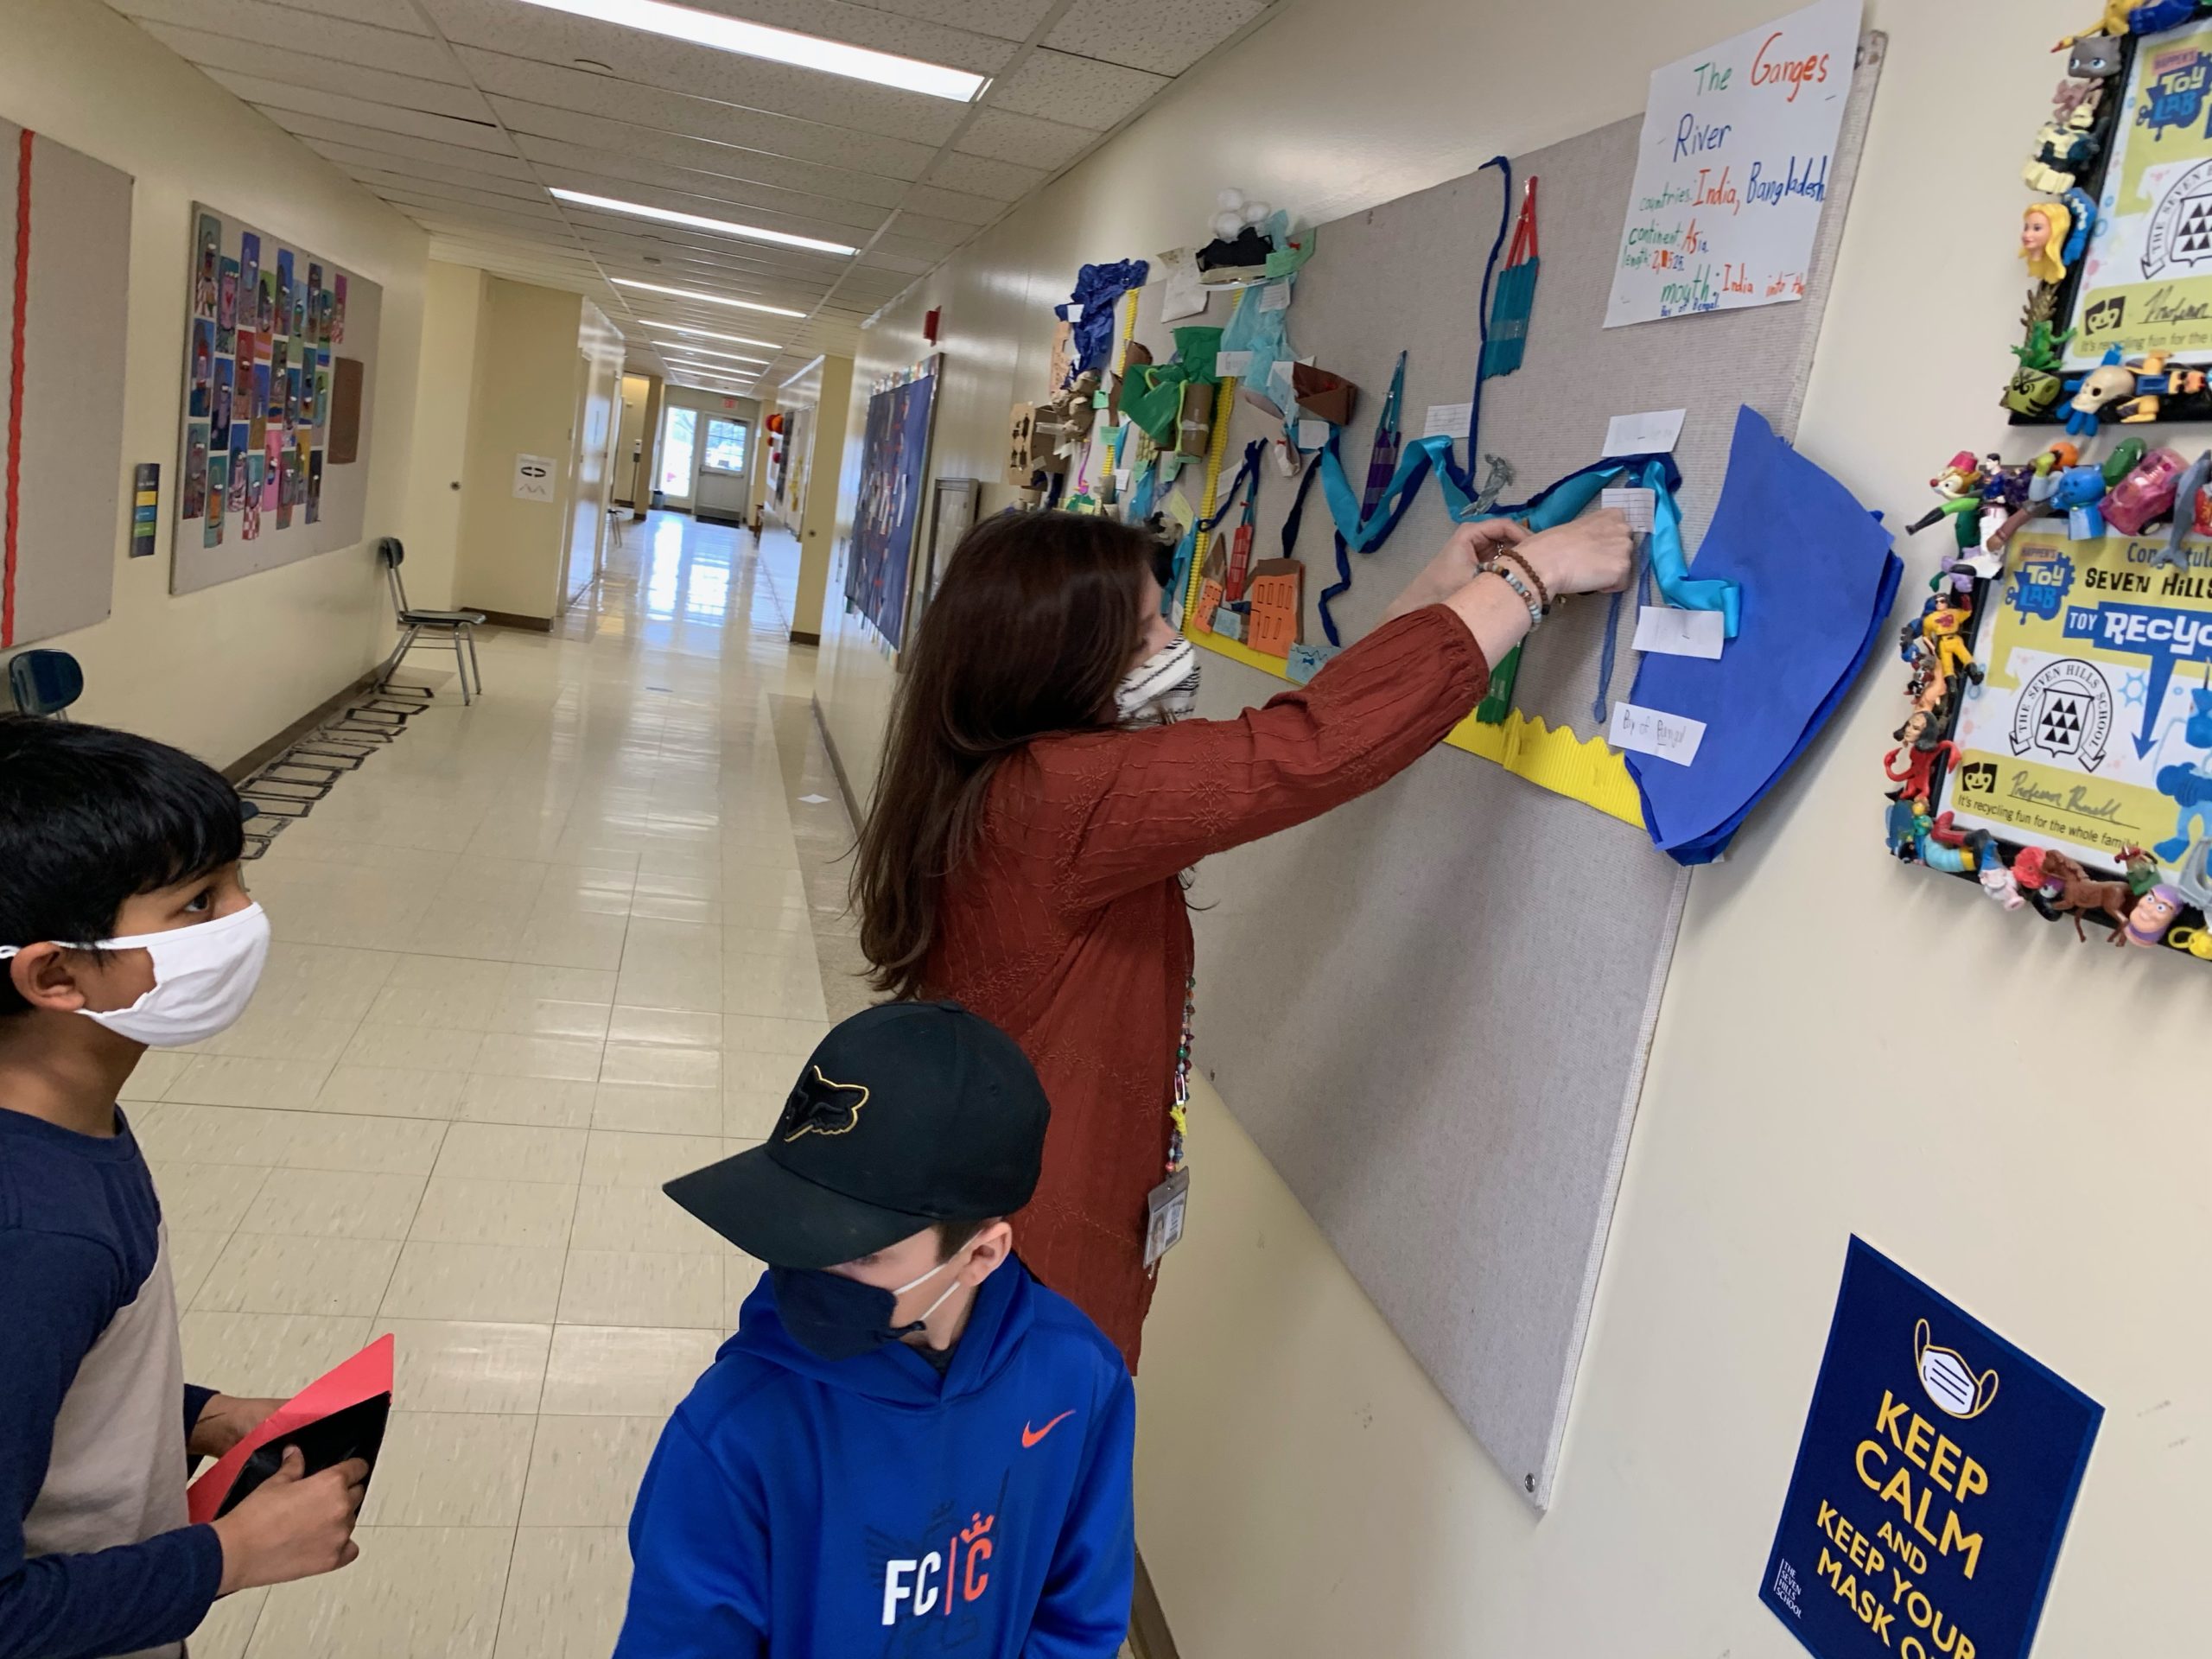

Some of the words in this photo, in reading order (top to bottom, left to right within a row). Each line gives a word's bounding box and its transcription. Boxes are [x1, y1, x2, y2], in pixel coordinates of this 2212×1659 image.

[1694, 63, 1732, 96] The
[1751, 32, 1829, 102] Ganges
[1673, 113, 1732, 162] River
[1746, 156, 1827, 206] Bangladesh
[1722, 262, 1754, 293] India
[2019, 585, 2056, 609] LAB
[2085, 568, 2151, 593] SEVEN
[2069, 612, 2098, 631] TOY
[2018, 704, 2031, 733] THE
[2028, 666, 2062, 700] SEVEN
[2066, 664, 2101, 690] HILLS
[2089, 692, 2109, 749] SCHOOL
[1958, 794, 1972, 808] It's
[1974, 799, 2013, 822] recycling
[2016, 808, 2031, 823] fun
[2034, 814, 2049, 828] for
[2050, 819, 2067, 835] the
[2069, 826, 2099, 842] whole
[1875, 1389, 1989, 1504] KEEP
[1855, 1439, 1984, 1580] CALM
[1783, 1560, 1796, 1580] THE
[1877, 1521, 1927, 1575] AND
[1779, 1578, 1796, 1601] HILLS
[1781, 1570, 1802, 1596] SEVEN
[1816, 1498, 1885, 1576] KEEP
[1892, 1566, 1977, 1659] YOUR
[1816, 1547, 1896, 1648] MASK
[1776, 1586, 1802, 1620] SCHOOL
